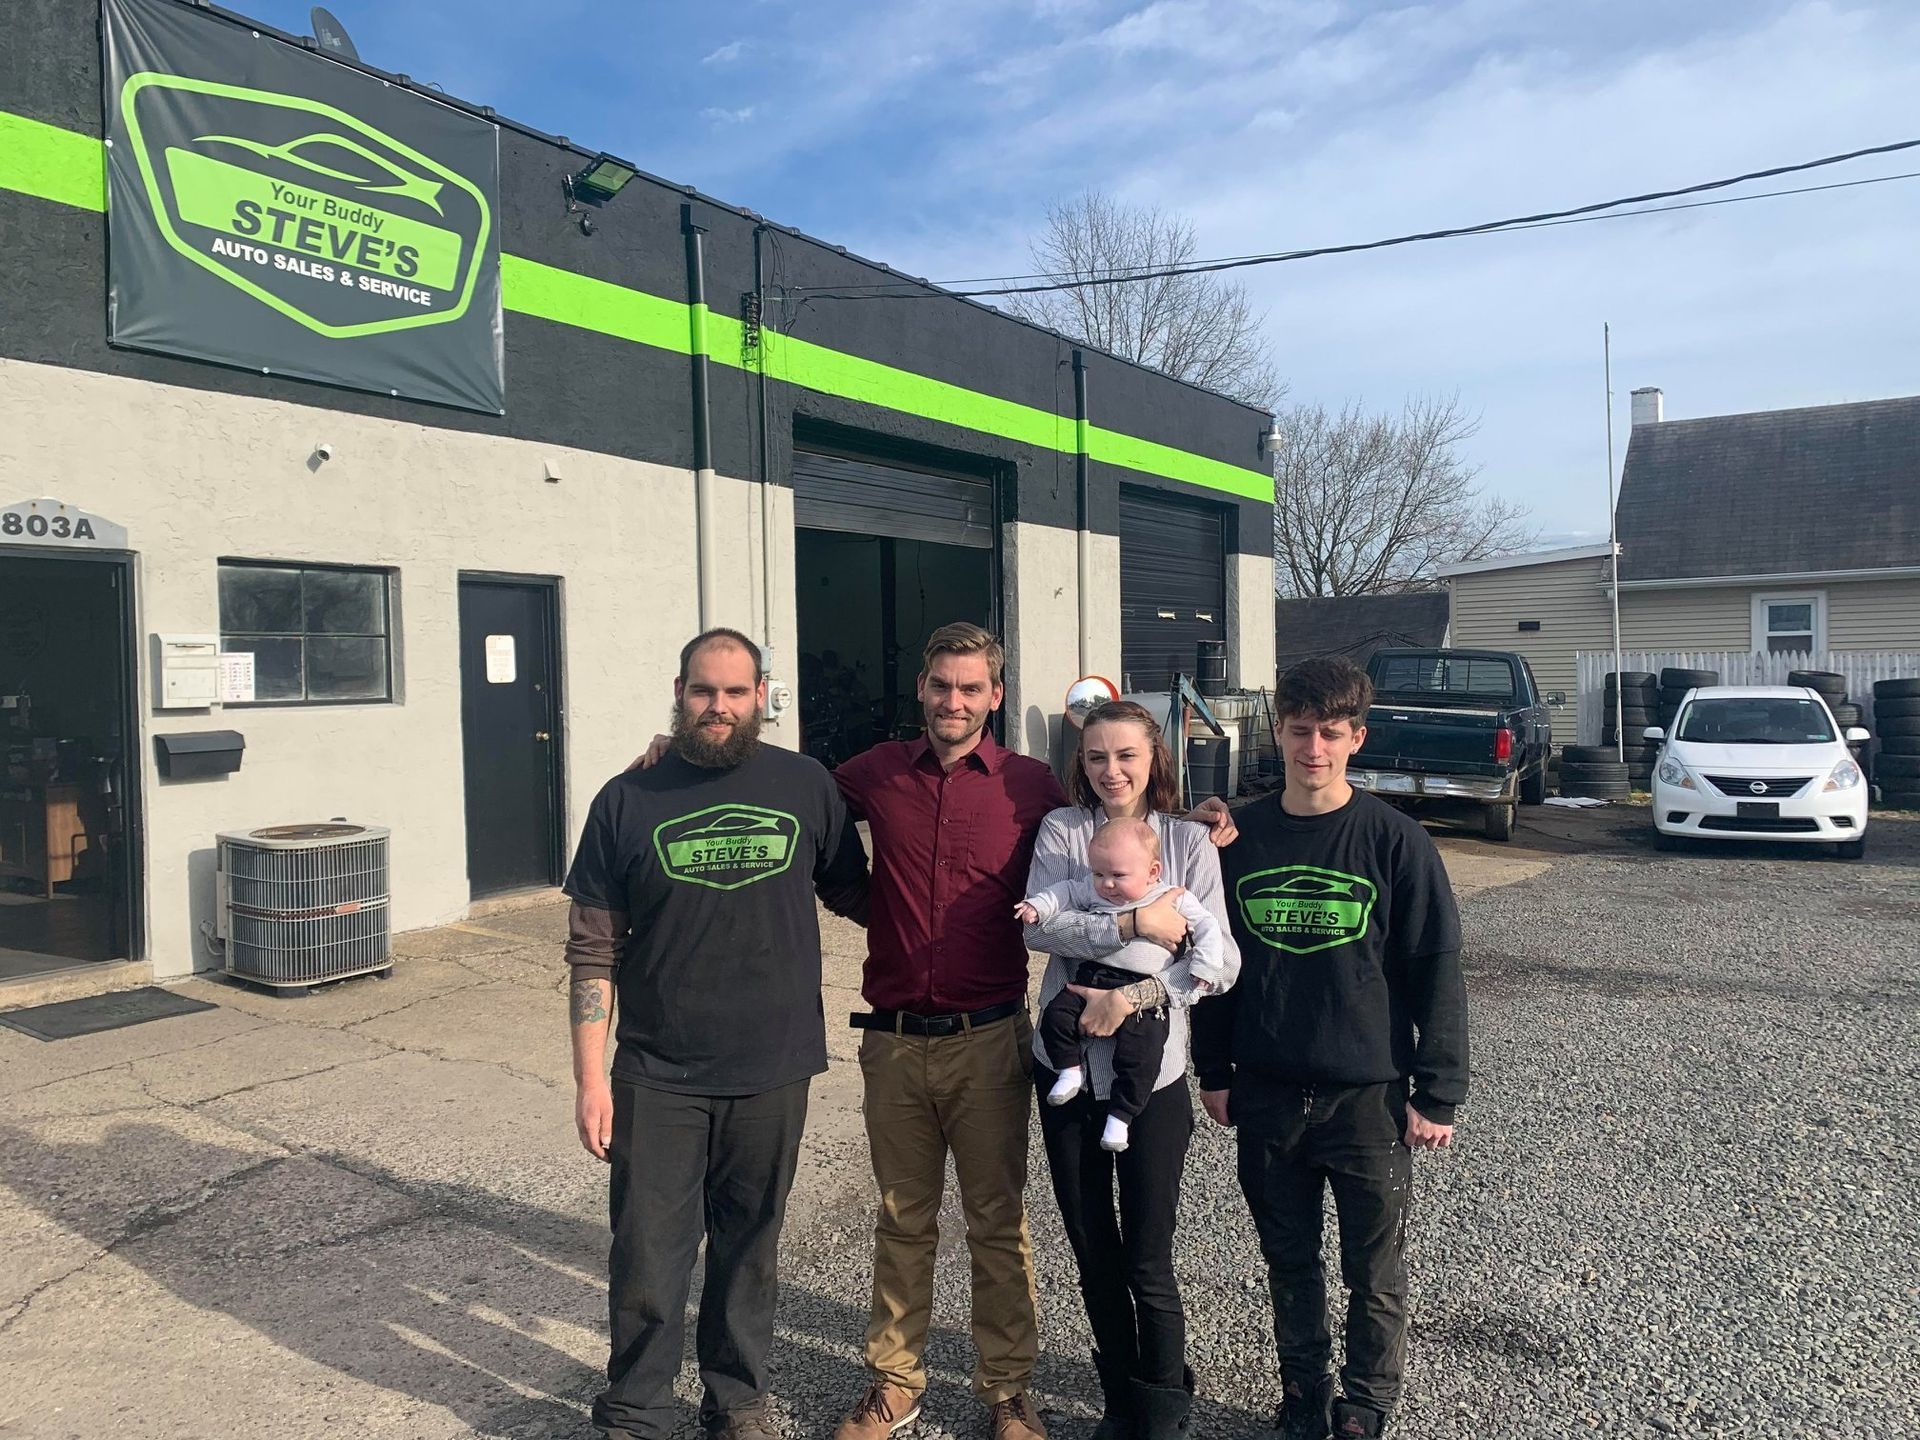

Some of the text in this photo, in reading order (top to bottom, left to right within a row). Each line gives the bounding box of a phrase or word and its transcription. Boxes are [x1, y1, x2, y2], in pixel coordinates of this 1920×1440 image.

[270, 182, 384, 233] Your Buddy
[231, 199, 420, 278] STEVE'S
[211, 238, 432, 307] AUTO SALES & SERVICE
[2, 512, 96, 540] 803A
[705, 836, 753, 847] Your Buddy
[691, 845, 769, 863] STEVE'S
[683, 866, 705, 874] AUTO
[707, 863, 730, 871] SALES
[740, 861, 774, 869] SERVICE
[1276, 900, 1323, 910] Your Buddy
[1264, 909, 1340, 926] STEVE'S
[1311, 927, 1346, 936] SERVICE
